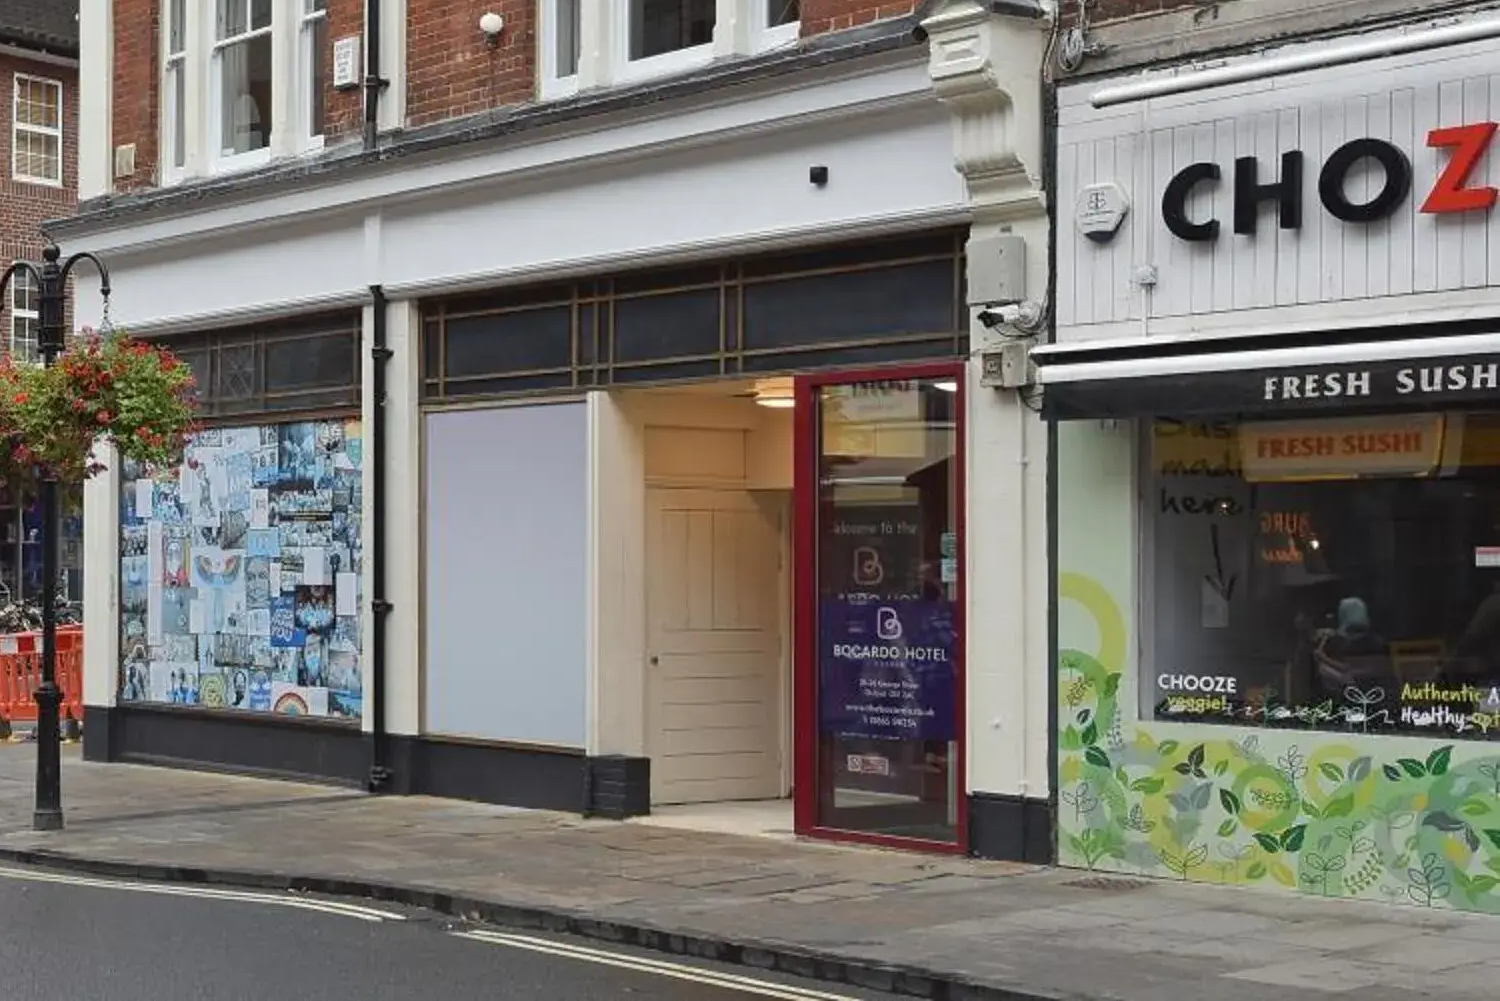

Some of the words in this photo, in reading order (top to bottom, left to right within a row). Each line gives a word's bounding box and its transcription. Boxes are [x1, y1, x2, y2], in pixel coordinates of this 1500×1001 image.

[1264, 372, 1370, 399] FRESH
[1257, 436, 1334, 459] FRESH
[1342, 431, 1423, 454] SUSHI
[833, 644, 900, 659] BOCARDO
[904, 647, 949, 662] HOTEL
[1158, 673, 1237, 694] CHOOZE
[1401, 682, 1480, 703] Authentic
[1401, 705, 1466, 734] Healthy
